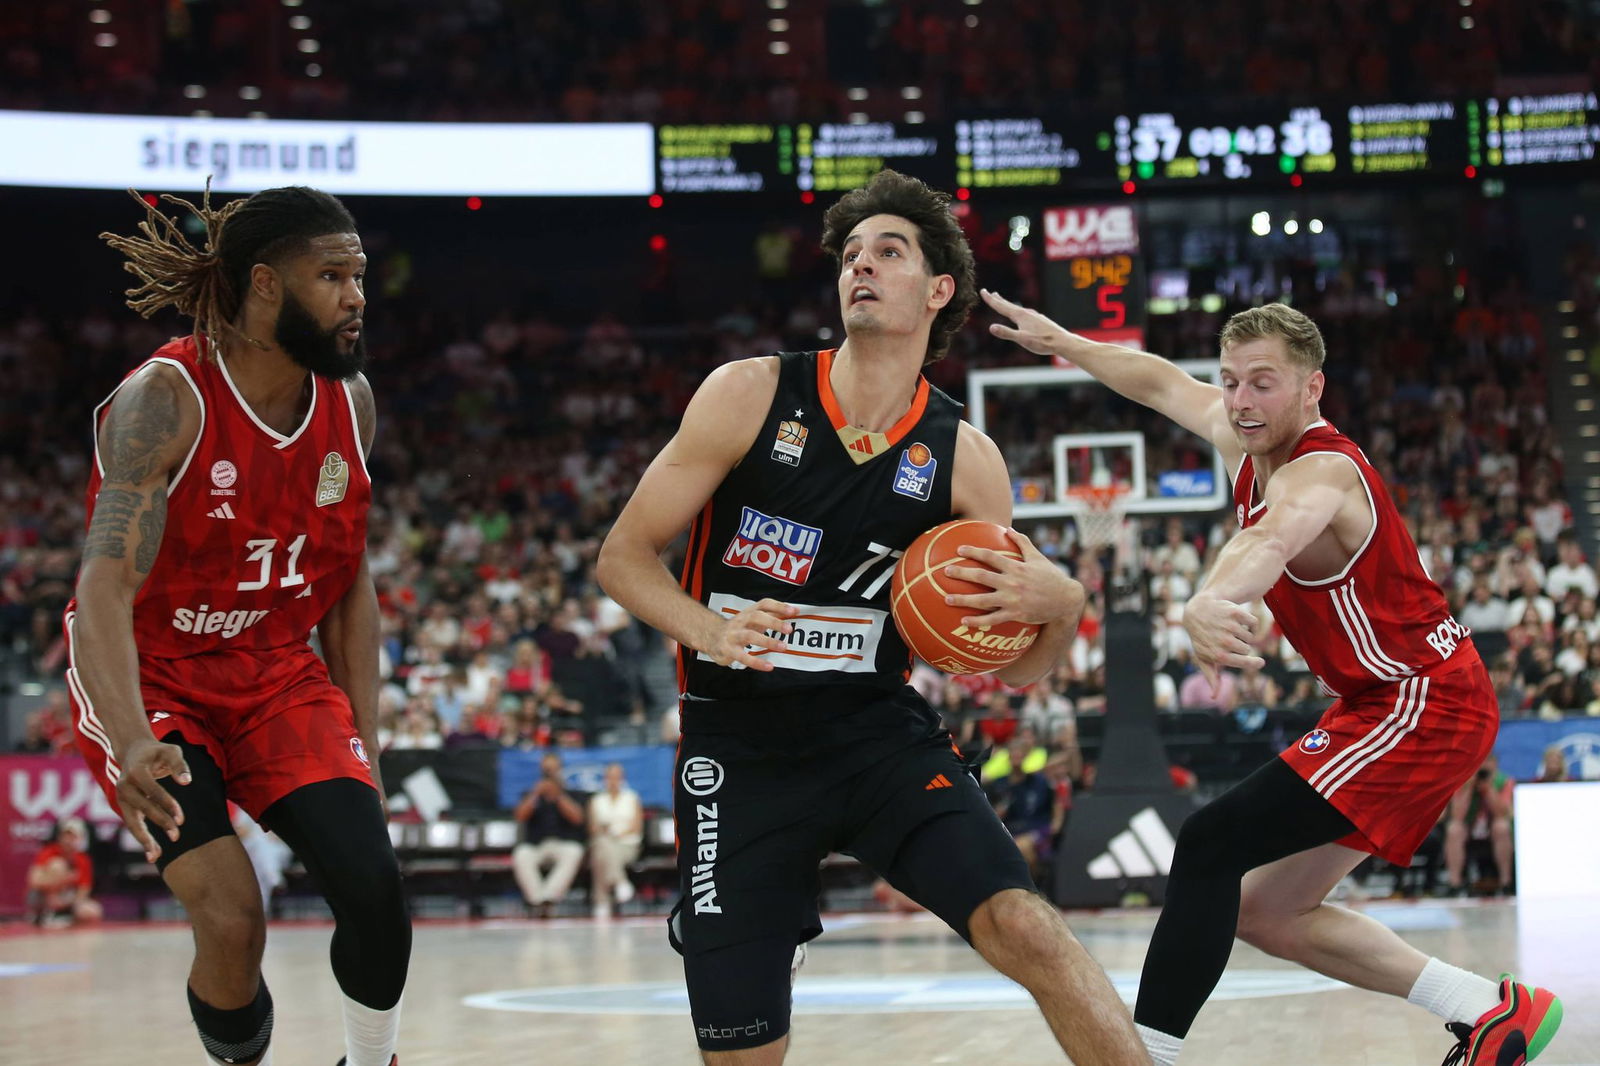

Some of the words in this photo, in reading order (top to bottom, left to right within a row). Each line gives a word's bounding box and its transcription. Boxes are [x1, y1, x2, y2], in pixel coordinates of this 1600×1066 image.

[142, 132, 356, 178] siegmund
[1096, 285, 1126, 329] 5
[778, 453, 793, 463] ulm
[319, 488, 340, 502] BBL
[896, 477, 925, 496] BBL
[740, 510, 818, 556] LIQUI
[236, 534, 307, 592] 31
[726, 537, 811, 581] MOLY
[837, 541, 905, 601] 77
[691, 802, 723, 916] Allianz
